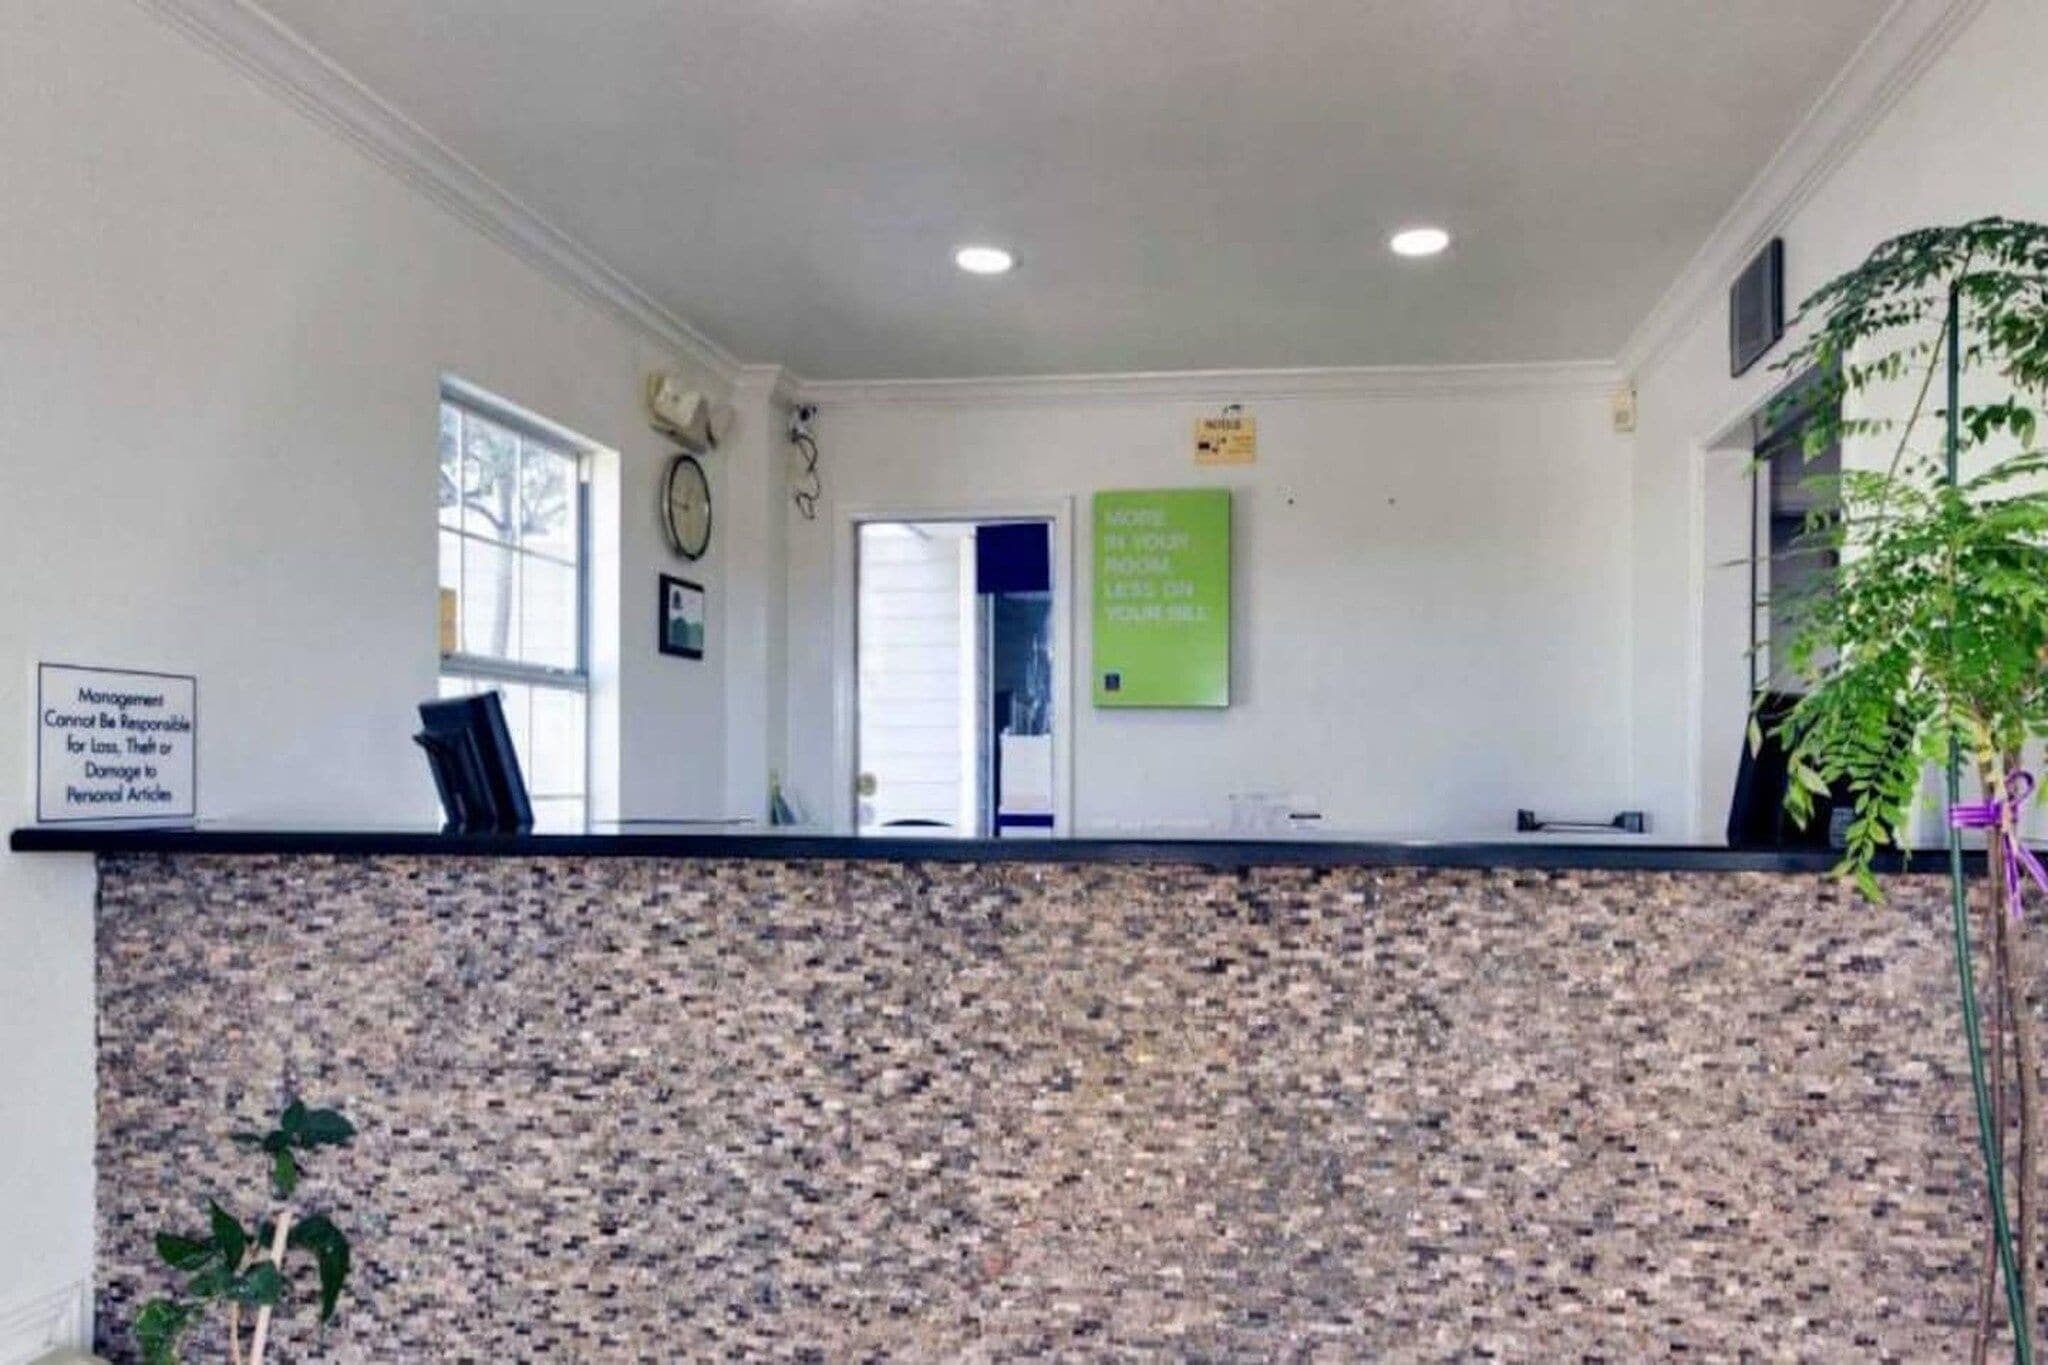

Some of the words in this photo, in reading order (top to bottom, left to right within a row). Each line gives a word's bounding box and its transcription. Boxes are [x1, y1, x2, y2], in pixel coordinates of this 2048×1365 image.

[78, 687, 164, 710] Management
[44, 709, 96, 728] Cannot
[100, 712, 116, 729] Be
[120, 713, 190, 733] Responsible
[67, 734, 85, 753] for
[126, 737, 157, 754] Theft
[159, 743, 172, 755] or
[85, 760, 141, 783] Damage
[145, 765, 157, 779] to
[67, 785, 123, 804] Personal
[127, 783, 172, 802] Articles
